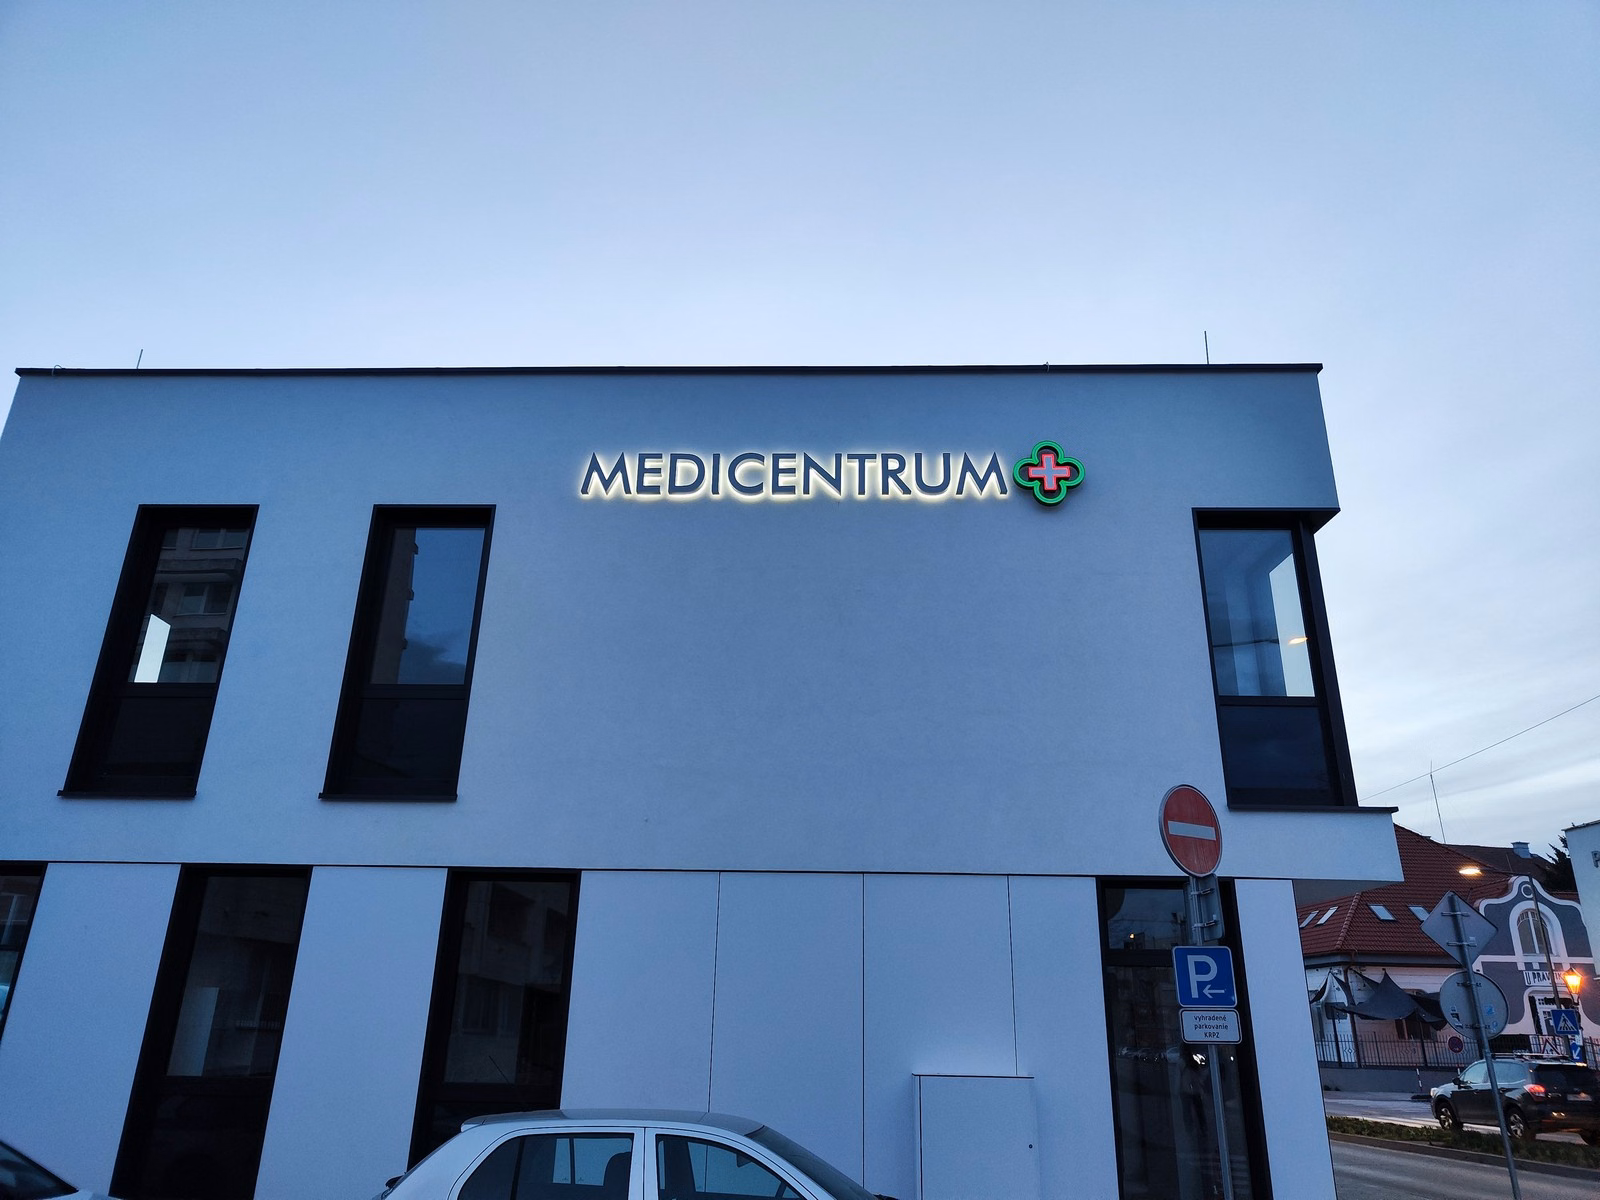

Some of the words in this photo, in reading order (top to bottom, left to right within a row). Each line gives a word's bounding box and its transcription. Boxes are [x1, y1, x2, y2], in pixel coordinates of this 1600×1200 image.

[580, 452, 1008, 496] MEDICENTRUM
[1187, 955, 1217, 998] P
[1193, 1014, 1227, 1022] vyhradené
[1194, 1023, 1229, 1031] parkovanie
[1203, 1031, 1220, 1039] KRPZ
